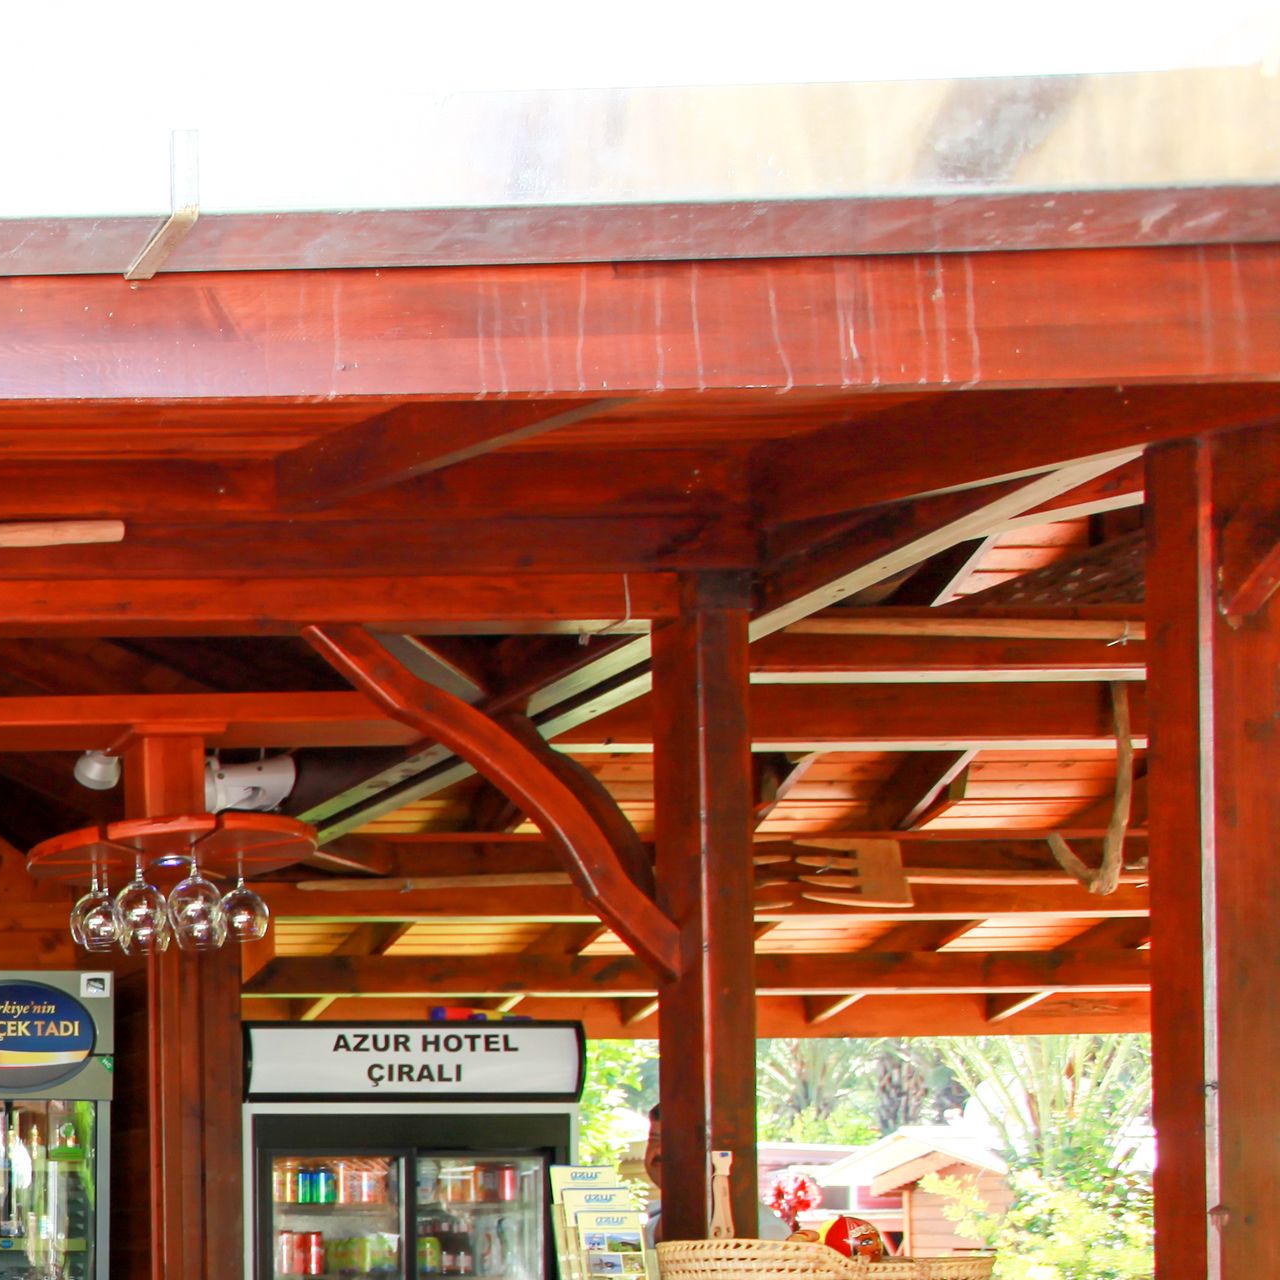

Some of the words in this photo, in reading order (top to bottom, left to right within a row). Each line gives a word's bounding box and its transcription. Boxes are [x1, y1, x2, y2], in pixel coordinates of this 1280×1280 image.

[34, 1021, 80, 1037] TADI
[333, 1034, 410, 1052] AZUR
[421, 1034, 519, 1052] HOTEL
[367, 1064, 462, 1087] ÇIRALI
